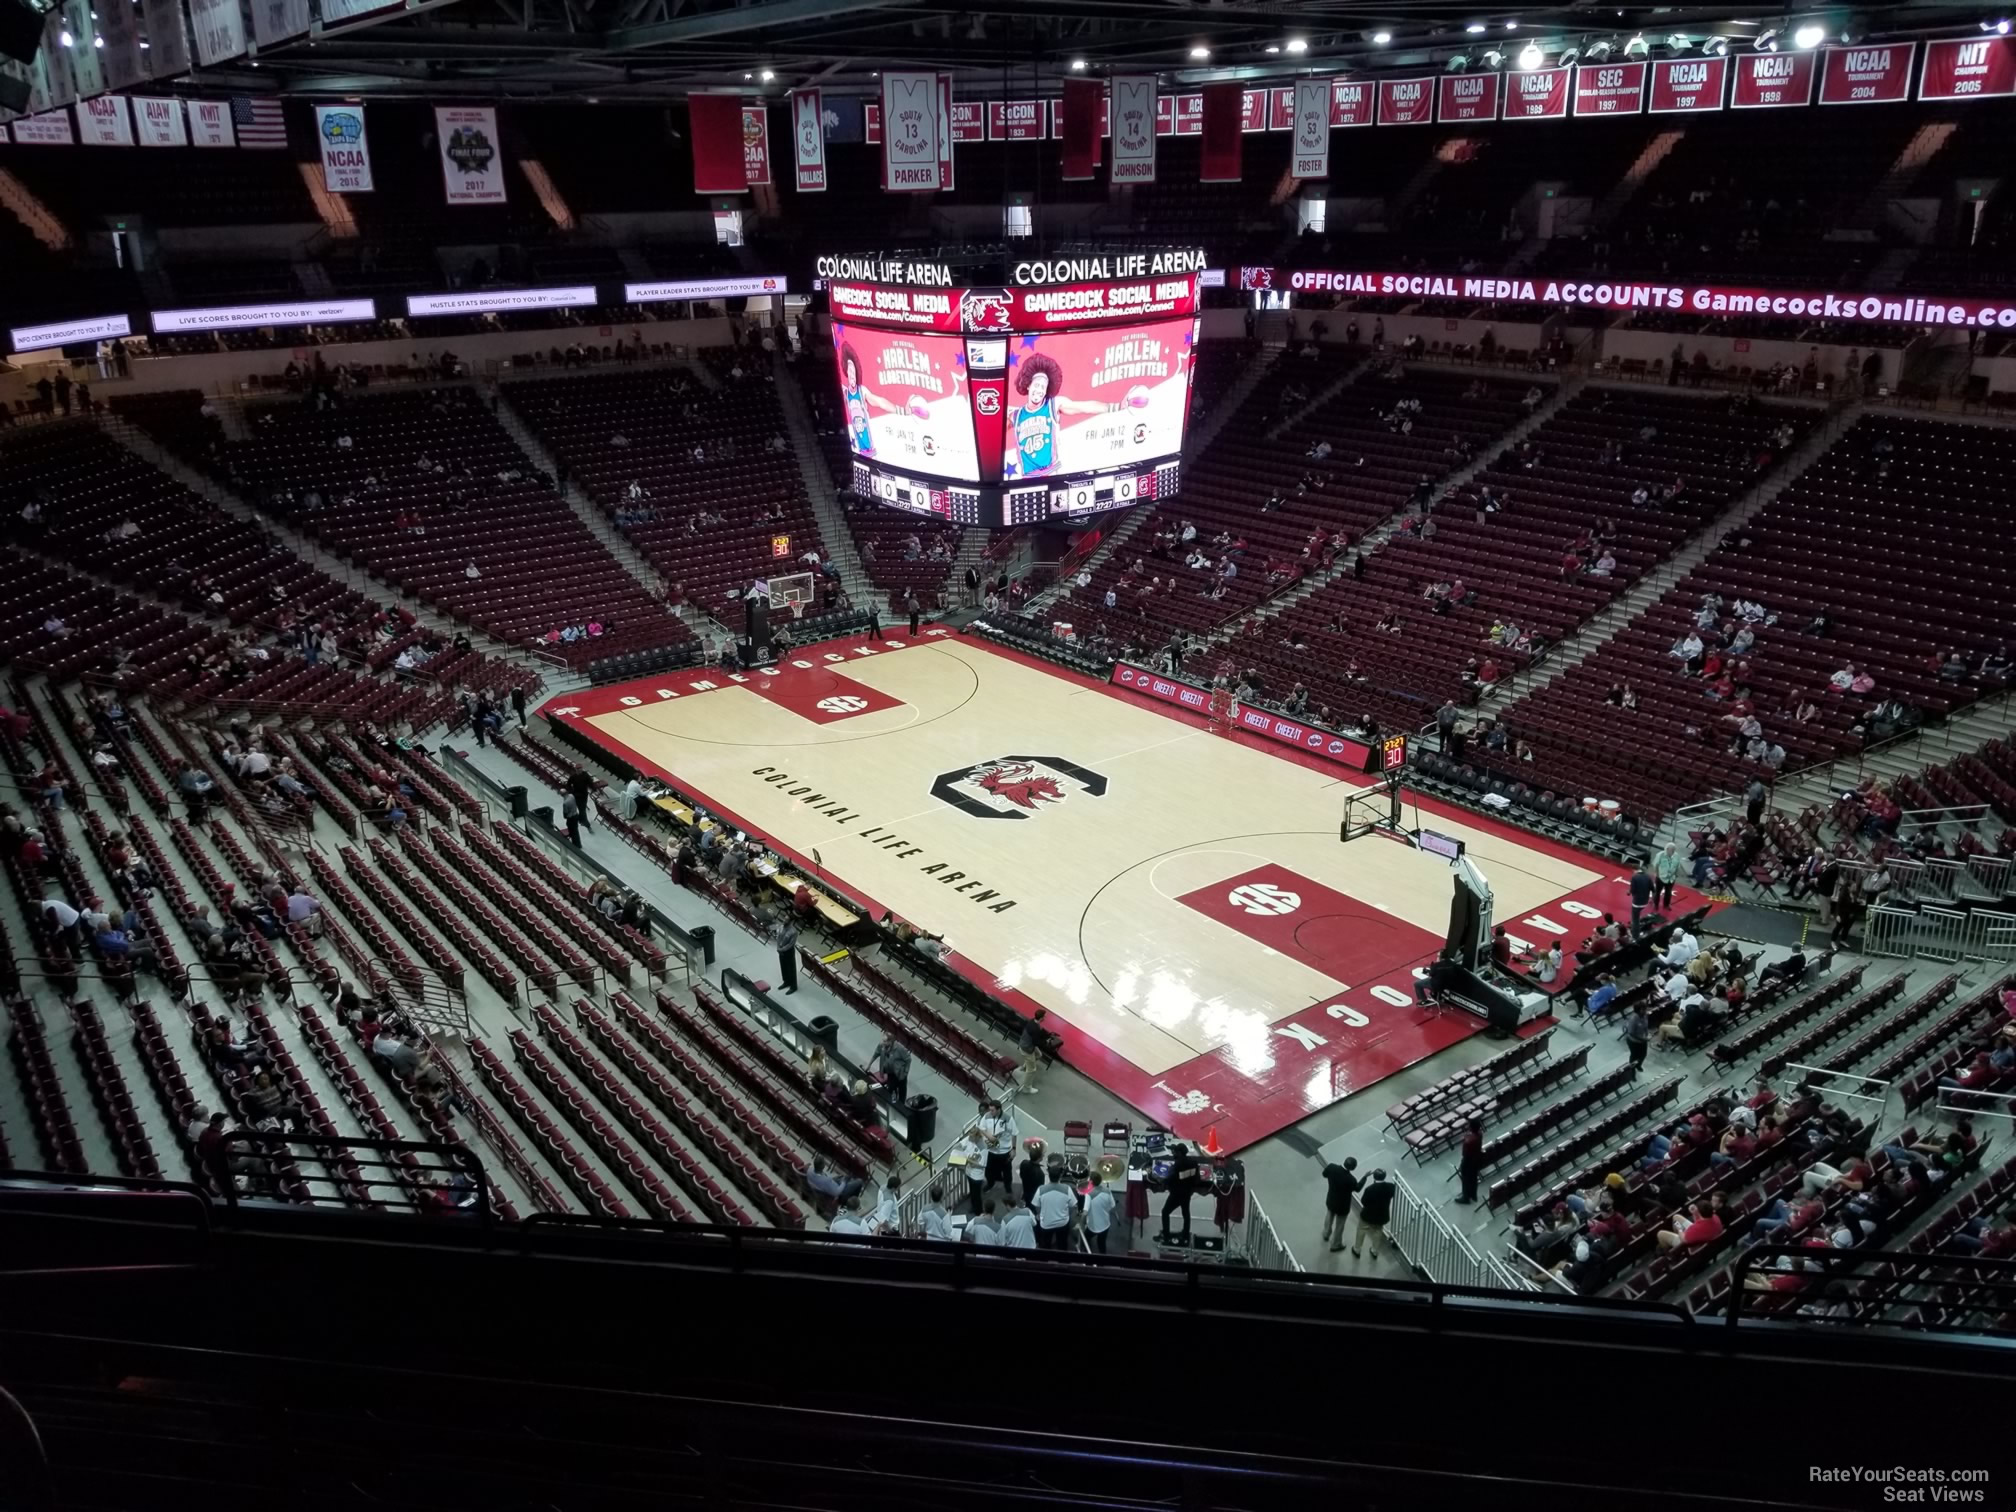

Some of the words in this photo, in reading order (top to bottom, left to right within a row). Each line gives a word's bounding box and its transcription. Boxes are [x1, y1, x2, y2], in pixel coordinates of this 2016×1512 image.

[1845, 50, 1891, 72] NCAA
[1957, 42, 1991, 66] NIT
[1669, 63, 1707, 84] NCAA
[1753, 57, 1794, 78] NCAA
[1954, 65, 1989, 76] CHAMPION
[1520, 74, 1553, 93] NCAA
[1597, 69, 1624, 88] SEC
[1756, 77, 1789, 87] TOURNAMENT
[1847, 72, 1885, 82] TOURNAMENT
[1392, 83, 1421, 101] NCAA
[1454, 78, 1484, 97] NCAA
[1671, 83, 1703, 92] TOURNAMENT
[1850, 86, 1876, 98] 2004
[1954, 81, 1983, 94] 2005
[1336, 87, 1362, 103] NCAA
[1676, 96, 1696, 107] 1997
[1759, 91, 1781, 103] 1998
[87, 99, 118, 117] NCAA
[146, 102, 171, 120] AIAW
[1526, 104, 1543, 115] 1989
[1599, 100, 1617, 110] 1997
[199, 104, 221, 121] NWIT
[899, 110, 923, 122] SOUTH
[1123, 110, 1143, 121] SOUTH
[1304, 111, 1321, 121] SOUTH
[1341, 113, 1355, 123] 1972
[1396, 112, 1412, 121] 1973
[1459, 107, 1475, 118] 1974
[905, 123, 918, 138] 13
[1128, 122, 1139, 136] 14
[1307, 122, 1317, 135] 53
[805, 131, 813, 144] 42
[1120, 136, 1148, 151] CAROLINA
[1300, 135, 1322, 148] CAROLINA
[472, 148, 491, 157] FOUR
[894, 139, 929, 155] CAROLINA
[327, 150, 366, 167] NCAA
[744, 147, 765, 162] CAA
[1115, 163, 1152, 177] JOHNSON
[1299, 160, 1322, 172] FOSTER
[340, 177, 360, 187] 2015
[800, 170, 824, 184] WALLACE
[894, 168, 932, 183] PARKER
[465, 181, 485, 191] 2017
[475, 191, 503, 199] CHAMPION
[816, 256, 879, 281] COLONIAL
[880, 260, 903, 284] LIFE
[906, 262, 953, 287] ARENA
[1014, 256, 1111, 286] COLONIAL
[1115, 254, 1147, 279] LIFE
[1150, 249, 1208, 275] ARENA
[636, 288, 660, 296] PLAYER
[661, 287, 682, 295] LEADER
[703, 284, 729, 292] BROUGHT
[1024, 288, 1106, 313] GAMECOCK
[1108, 283, 1153, 307] SOCIAL
[1155, 280, 1190, 302] MEDIA
[1291, 271, 1377, 293] OFFICIAL
[1382, 275, 1458, 297] SOCIAL
[1464, 279, 1536, 300] MEDIA
[1543, 282, 1684, 309] ACCOUNTS
[430, 301, 456, 309] HUSTLE
[457, 299, 478, 307] STATS
[479, 298, 511, 306] BROUGHT
[832, 286, 874, 308] GAMECOCK
[875, 290, 911, 312] SOCIAL
[913, 294, 951, 314] MEDIA
[198, 315, 230, 323] SCORES
[231, 312, 269, 321] BROUGHT
[282, 310, 300, 318] YOU
[301, 309, 312, 317] BY:
[318, 307, 344, 316] verizon
[1045, 300, 1176, 323] GamecocksOnline.com/Connect
[32, 333, 52, 342] CENTER
[53, 330, 77, 339] BROUGHT
[86, 326, 97, 334] YOU
[1104, 340, 1162, 367] HARLEM
[882, 347, 931, 375] HARLEM
[1091, 362, 1169, 388] GLOBETROTTERS
[1085, 427, 1099, 441] FRI
[1102, 426, 1117, 439] JAN
[1024, 434, 1045, 455] 45
[1109, 438, 1125, 451] 7PM
[885, 483, 893, 497] 0
[1121, 483, 1130, 497] 0
[916, 491, 925, 505] 0
[1077, 491, 1087, 505] 0
[1096, 501, 1113, 510] 27:27
[774, 544, 788, 556] 30
[816, 695, 868, 714] SEC
[1384, 736, 1405, 752] 27:27
[1386, 747, 1402, 767] 30
[752, 766, 860, 825] COLONIAL
[859, 827, 924, 860] LIFE
[919, 862, 1018, 915] ARENA
[1228, 883, 1301, 916] SEC
